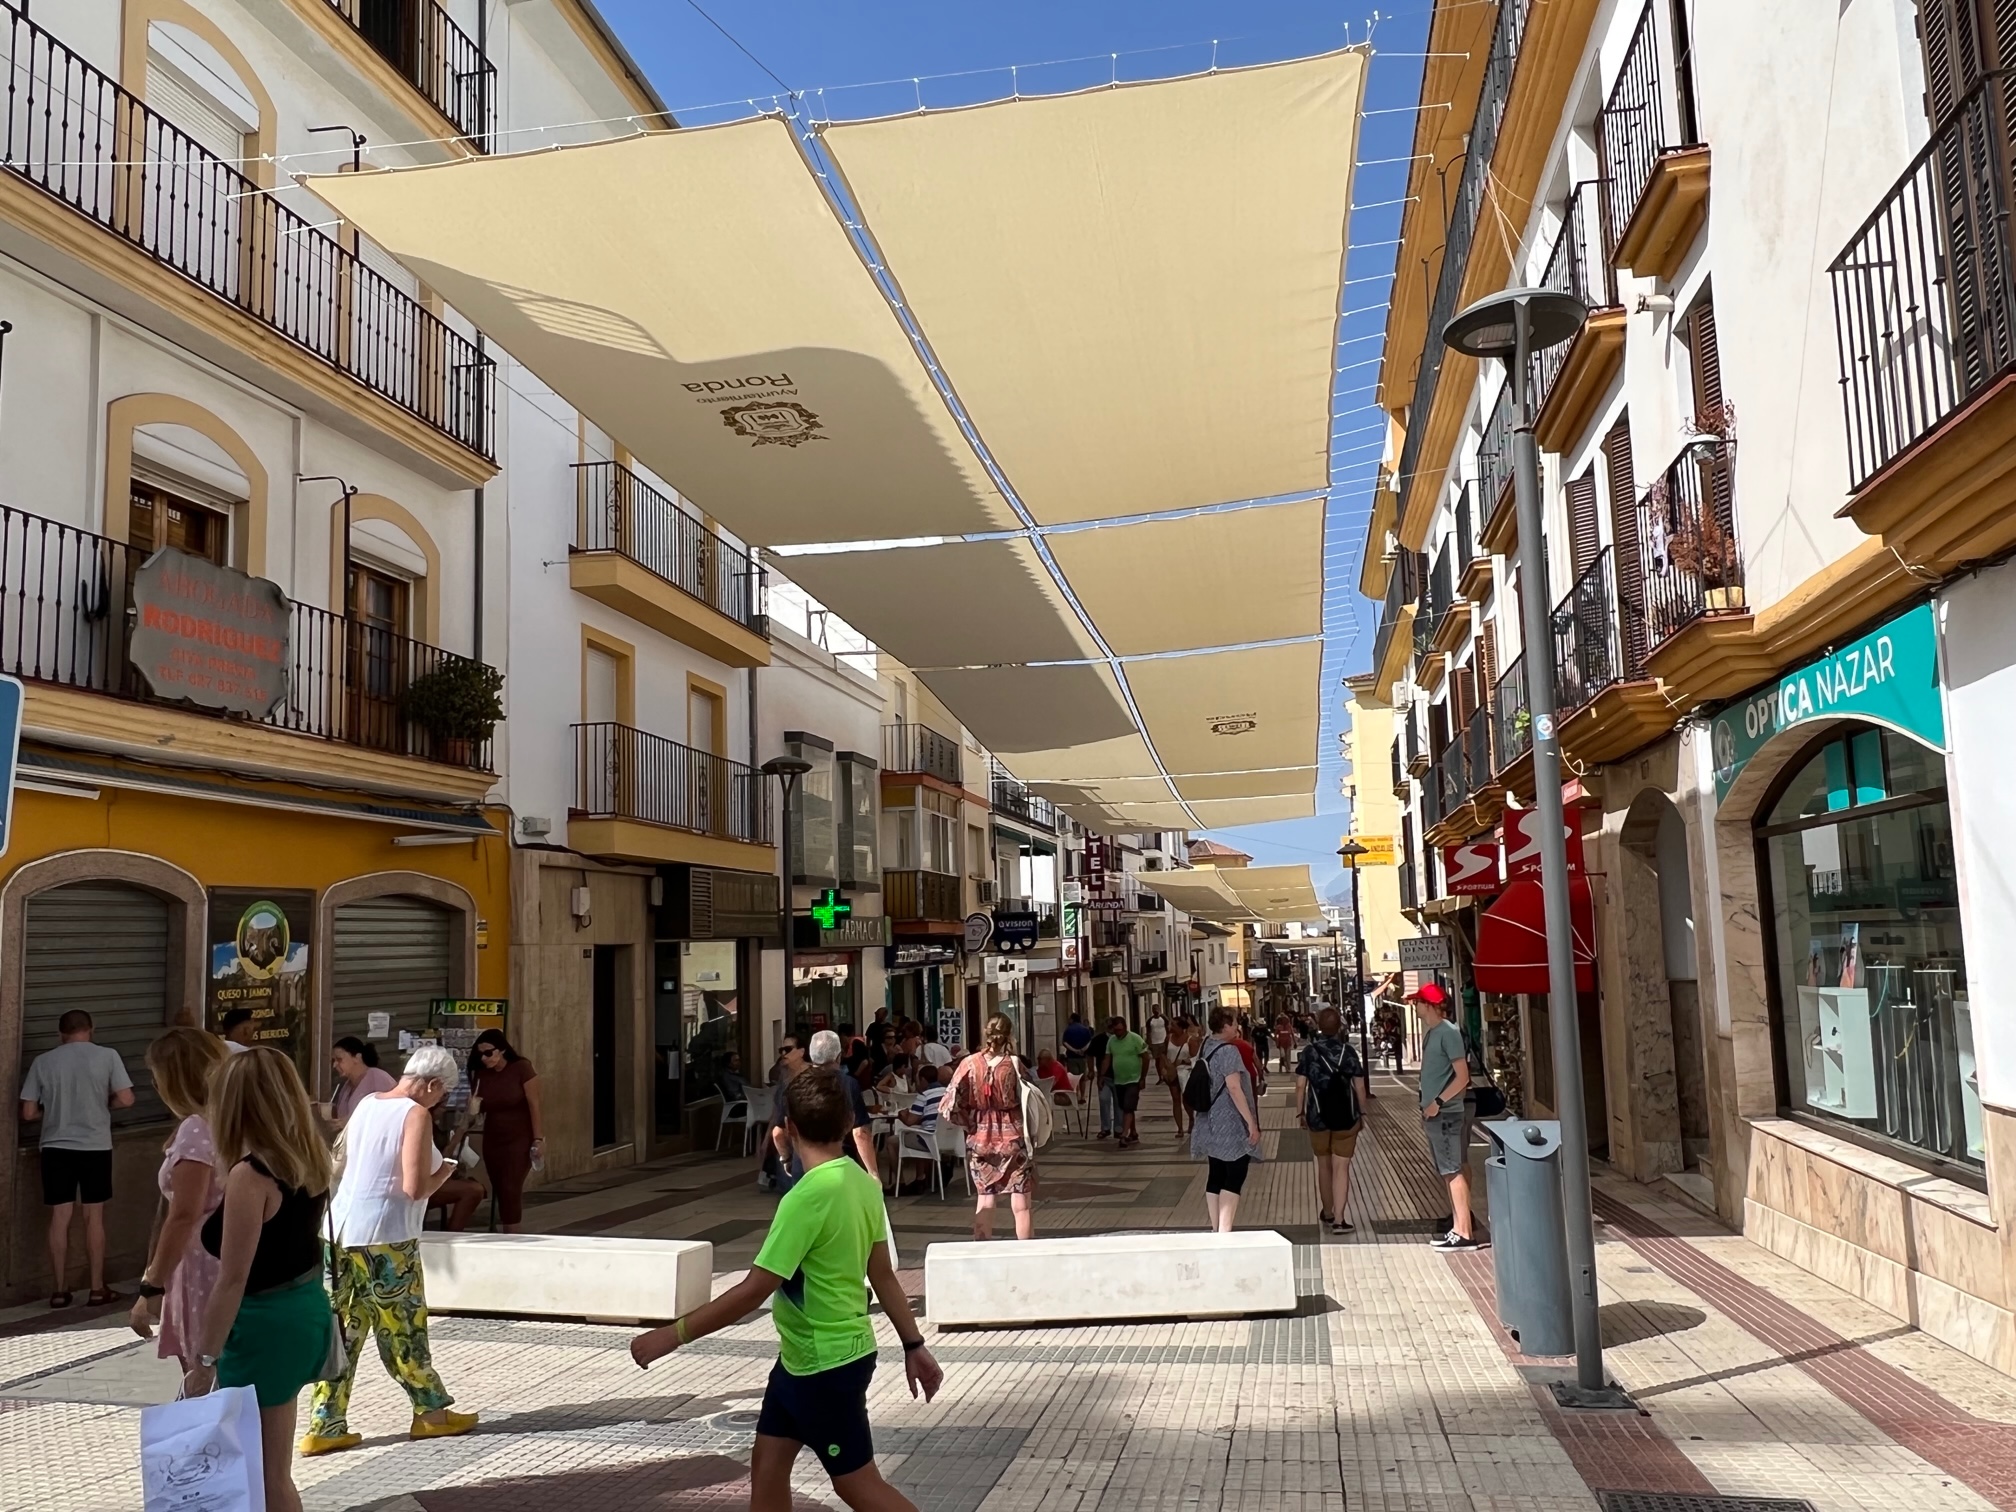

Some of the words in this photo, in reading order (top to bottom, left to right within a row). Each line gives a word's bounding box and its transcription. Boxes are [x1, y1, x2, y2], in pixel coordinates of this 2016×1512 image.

[681, 373, 794, 394] Ronda
[696, 388, 798, 404] Ayuntamiento
[1816, 635, 1895, 709] NAZAR
[1453, 884, 1495, 892] SPORTIUM
[1089, 900, 1124, 909] ARUNDA
[1404, 945, 1440, 953] DENTAL
[218, 989, 241, 1000] QUESO
[458, 1003, 493, 1012] ONCE
[940, 1011, 961, 1019] PLAN
